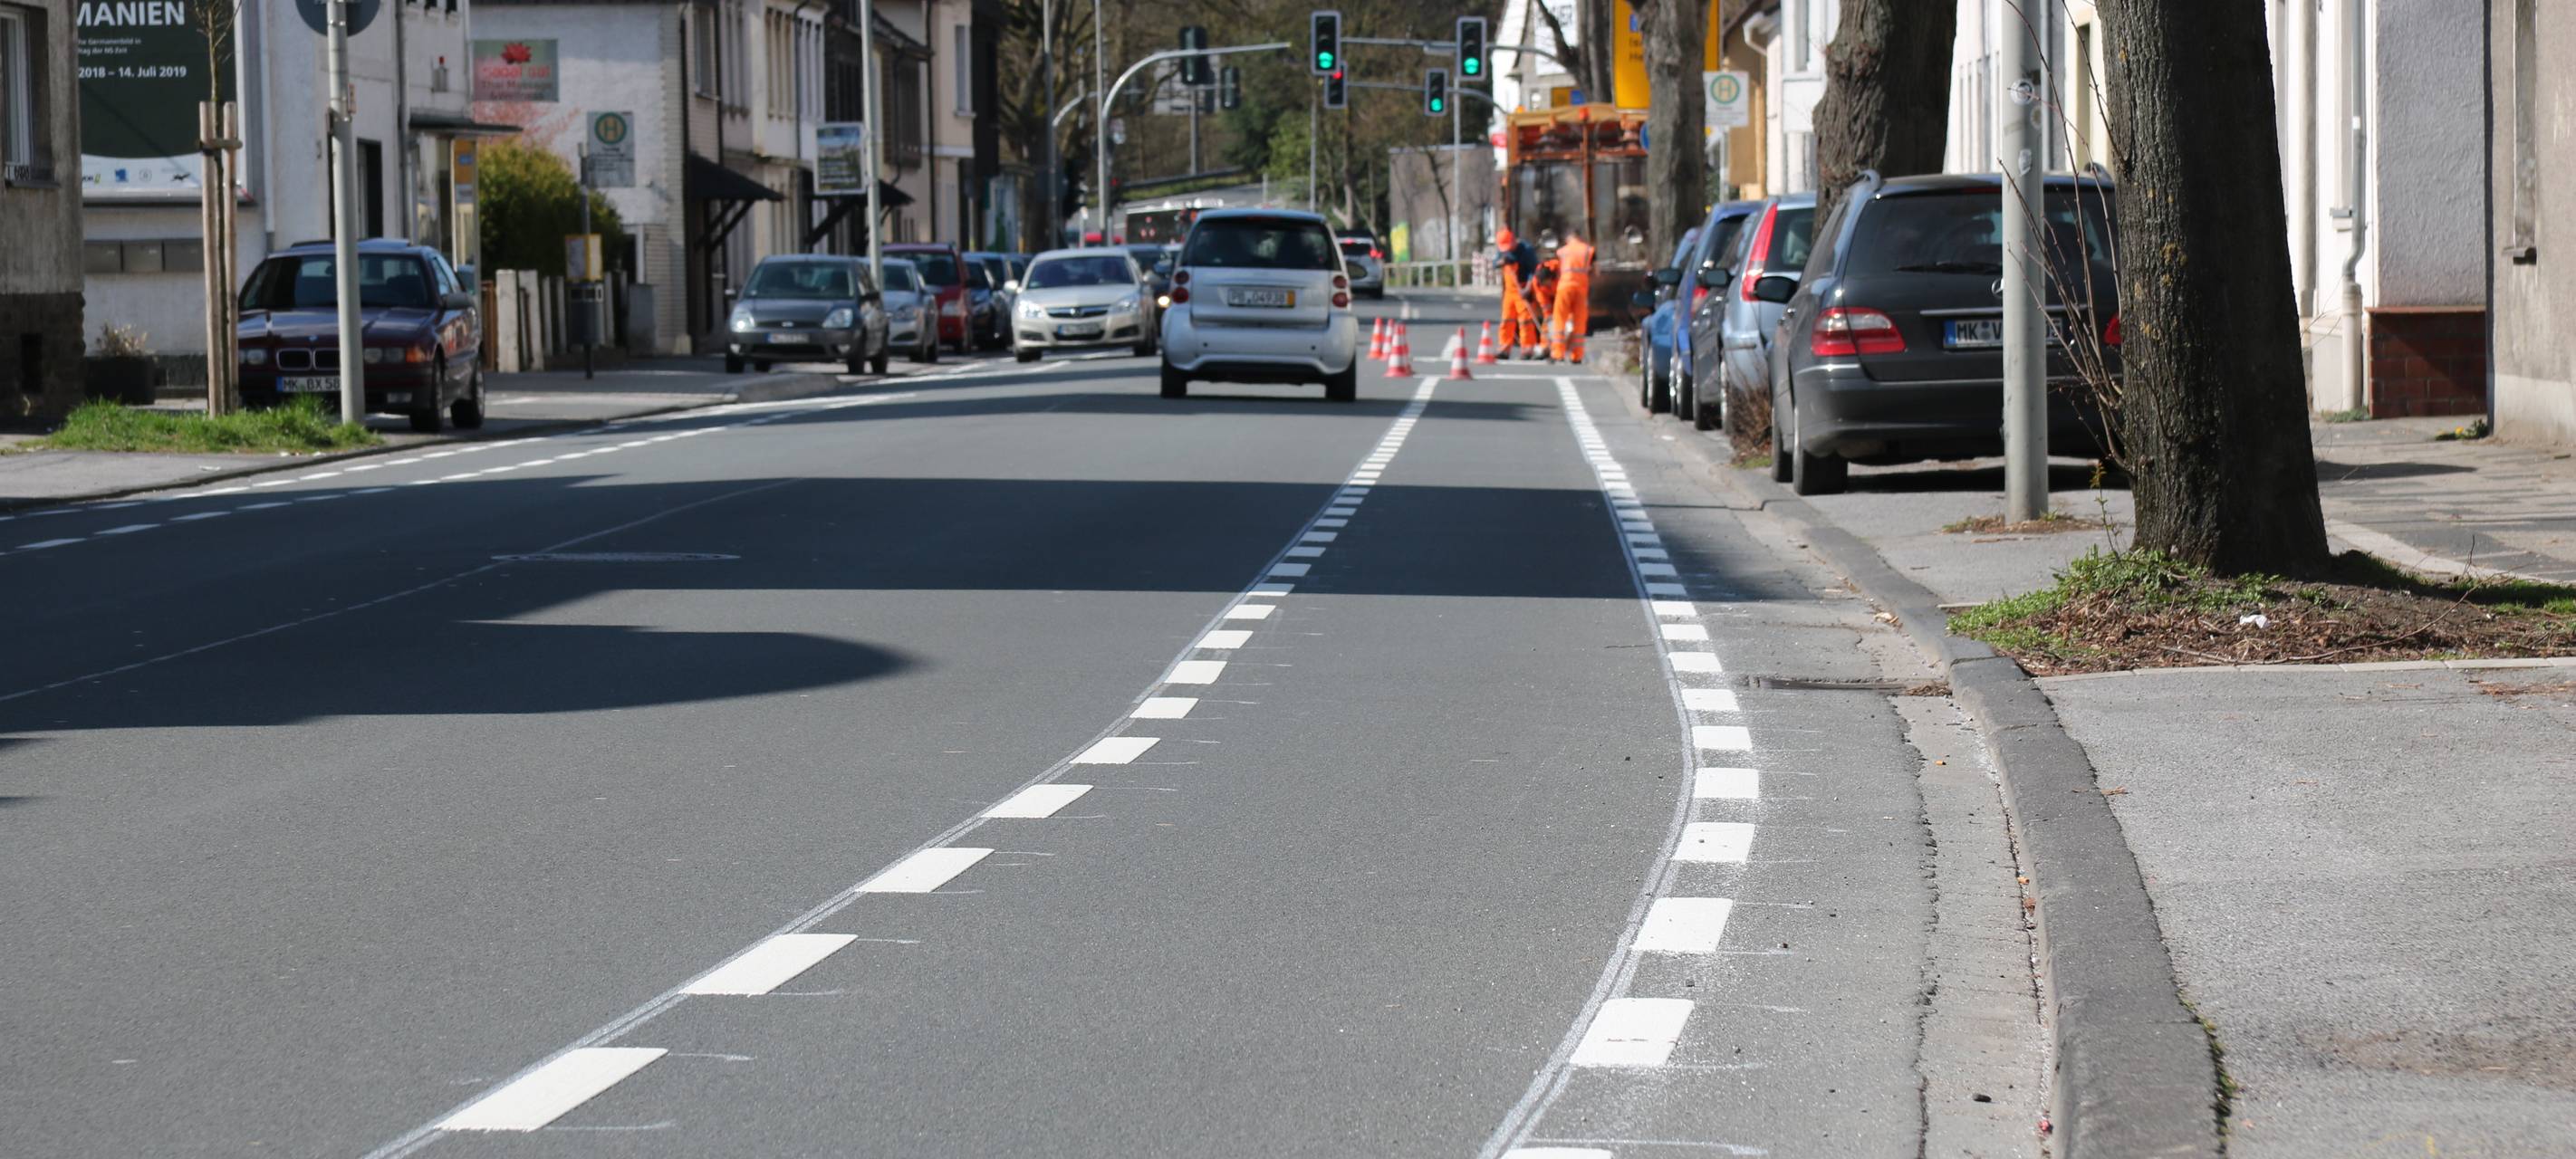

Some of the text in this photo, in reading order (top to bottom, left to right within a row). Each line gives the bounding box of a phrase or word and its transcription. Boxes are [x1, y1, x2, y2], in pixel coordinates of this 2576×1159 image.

[79, 67, 106, 79] 2018
[119, 67, 134, 78] 14.
[138, 66, 157, 78] Juli
[159, 65, 187, 78] 2019
[1957, 323, 1979, 340] MK
[284, 378, 298, 390] MK
